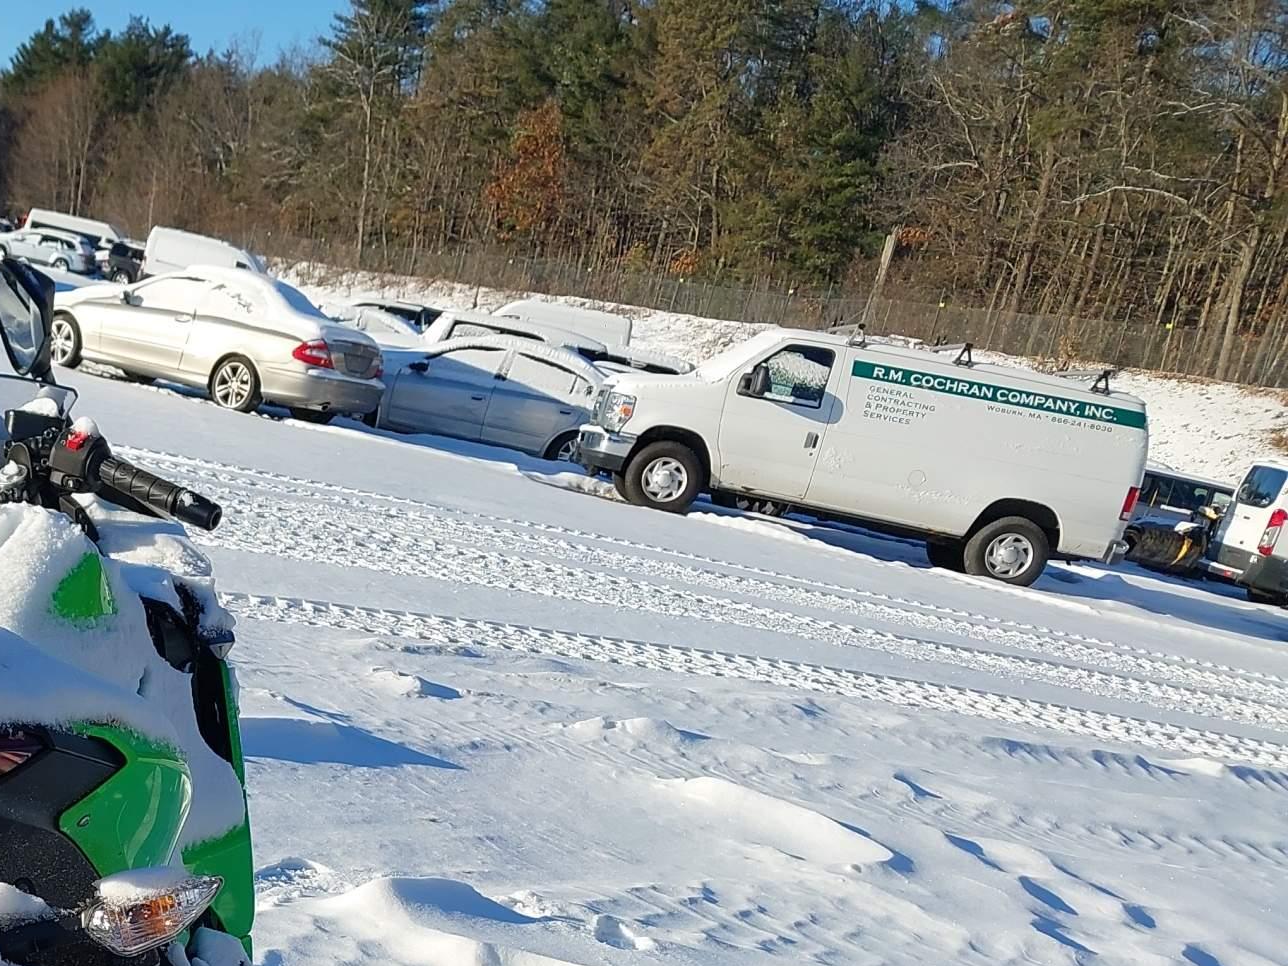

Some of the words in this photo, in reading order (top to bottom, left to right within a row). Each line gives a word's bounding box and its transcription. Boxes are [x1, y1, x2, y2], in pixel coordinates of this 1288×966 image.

[869, 385, 914, 399] GENERAL
[872, 366, 906, 383] R.M.
[910, 373, 993, 399] COCHRAN
[996, 389, 1080, 415] COMPANY,
[1084, 405, 1117, 421] INC.
[864, 401, 872, 409] &
[875, 403, 927, 419] PROPERTY
[866, 394, 936, 412] CONTRACTING
[863, 410, 911, 425] SERVICES
[1028, 412, 1042, 420] MA
